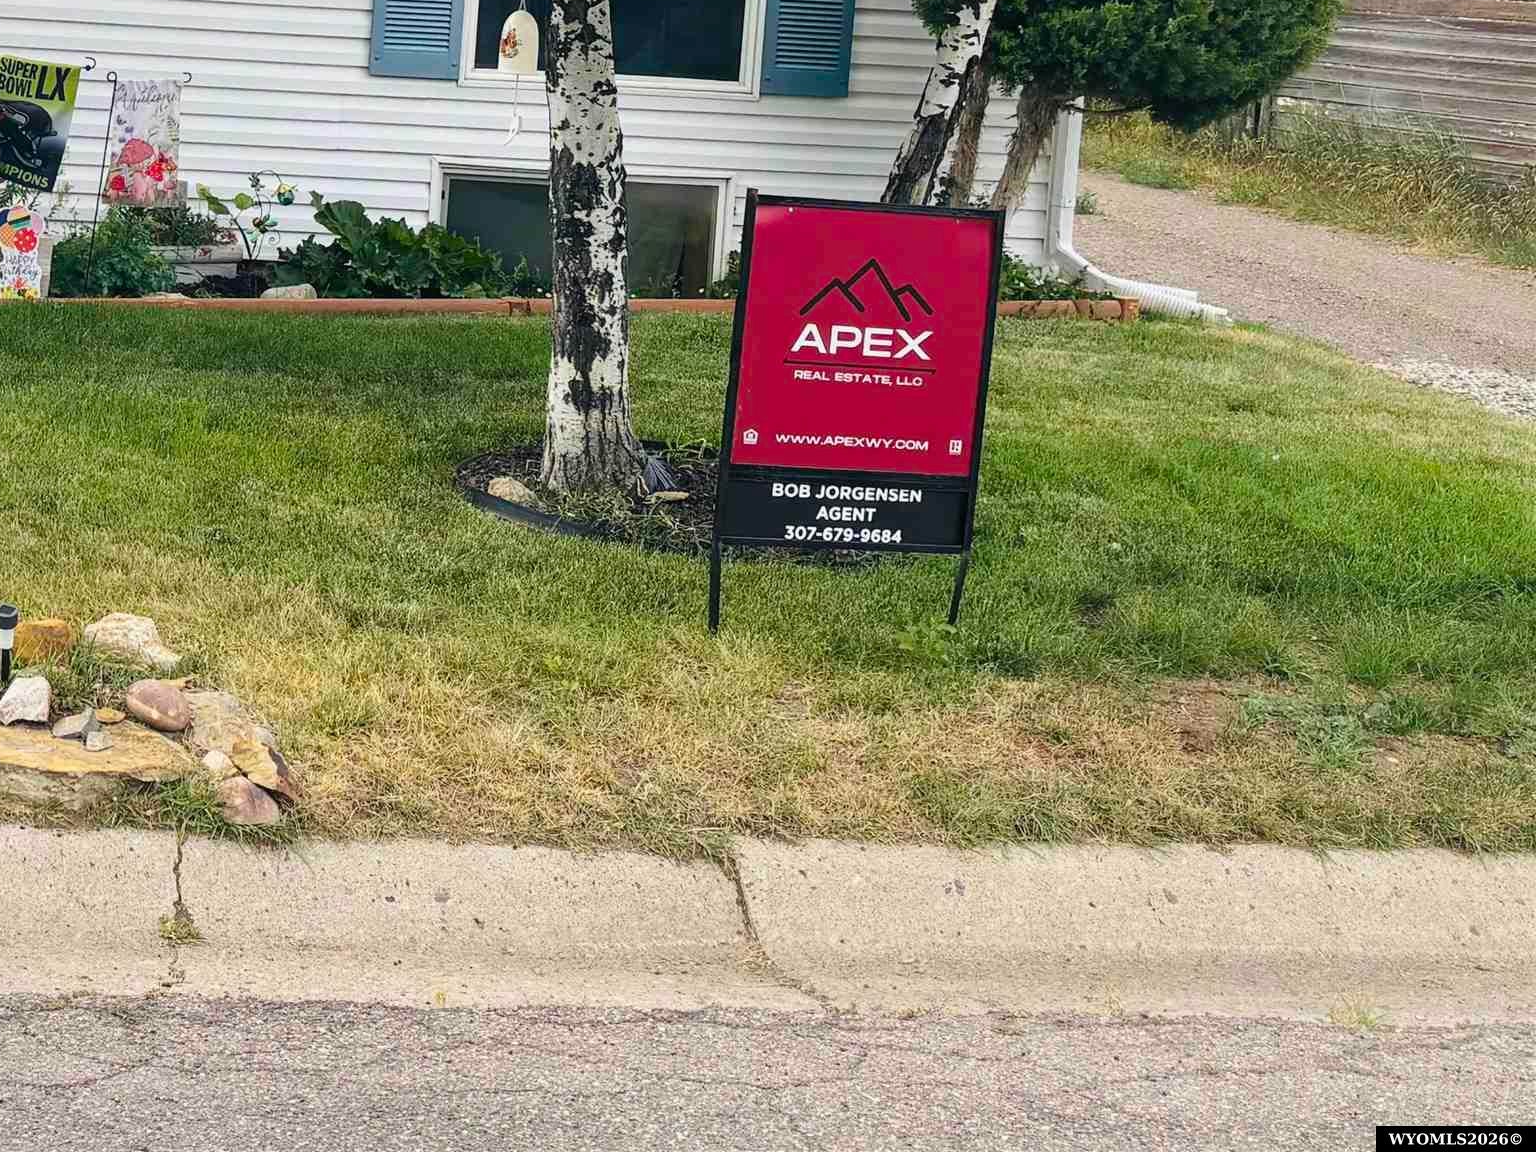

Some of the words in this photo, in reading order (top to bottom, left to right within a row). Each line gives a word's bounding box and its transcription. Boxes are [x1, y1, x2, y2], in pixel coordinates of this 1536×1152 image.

[0, 56, 39, 80] SUPER
[35, 64, 72, 102] LX
[790, 323, 934, 361] APEX
[794, 369, 830, 381] REAL
[834, 372, 893, 386] ESTATE,
[896, 375, 923, 386] LLC
[775, 433, 929, 451] WWW.APEXWY.COM
[772, 483, 811, 498] BOB
[815, 484, 922, 503] JORGENSEN
[816, 506, 876, 522] AGENT
[784, 525, 902, 544] 307-679-9684
